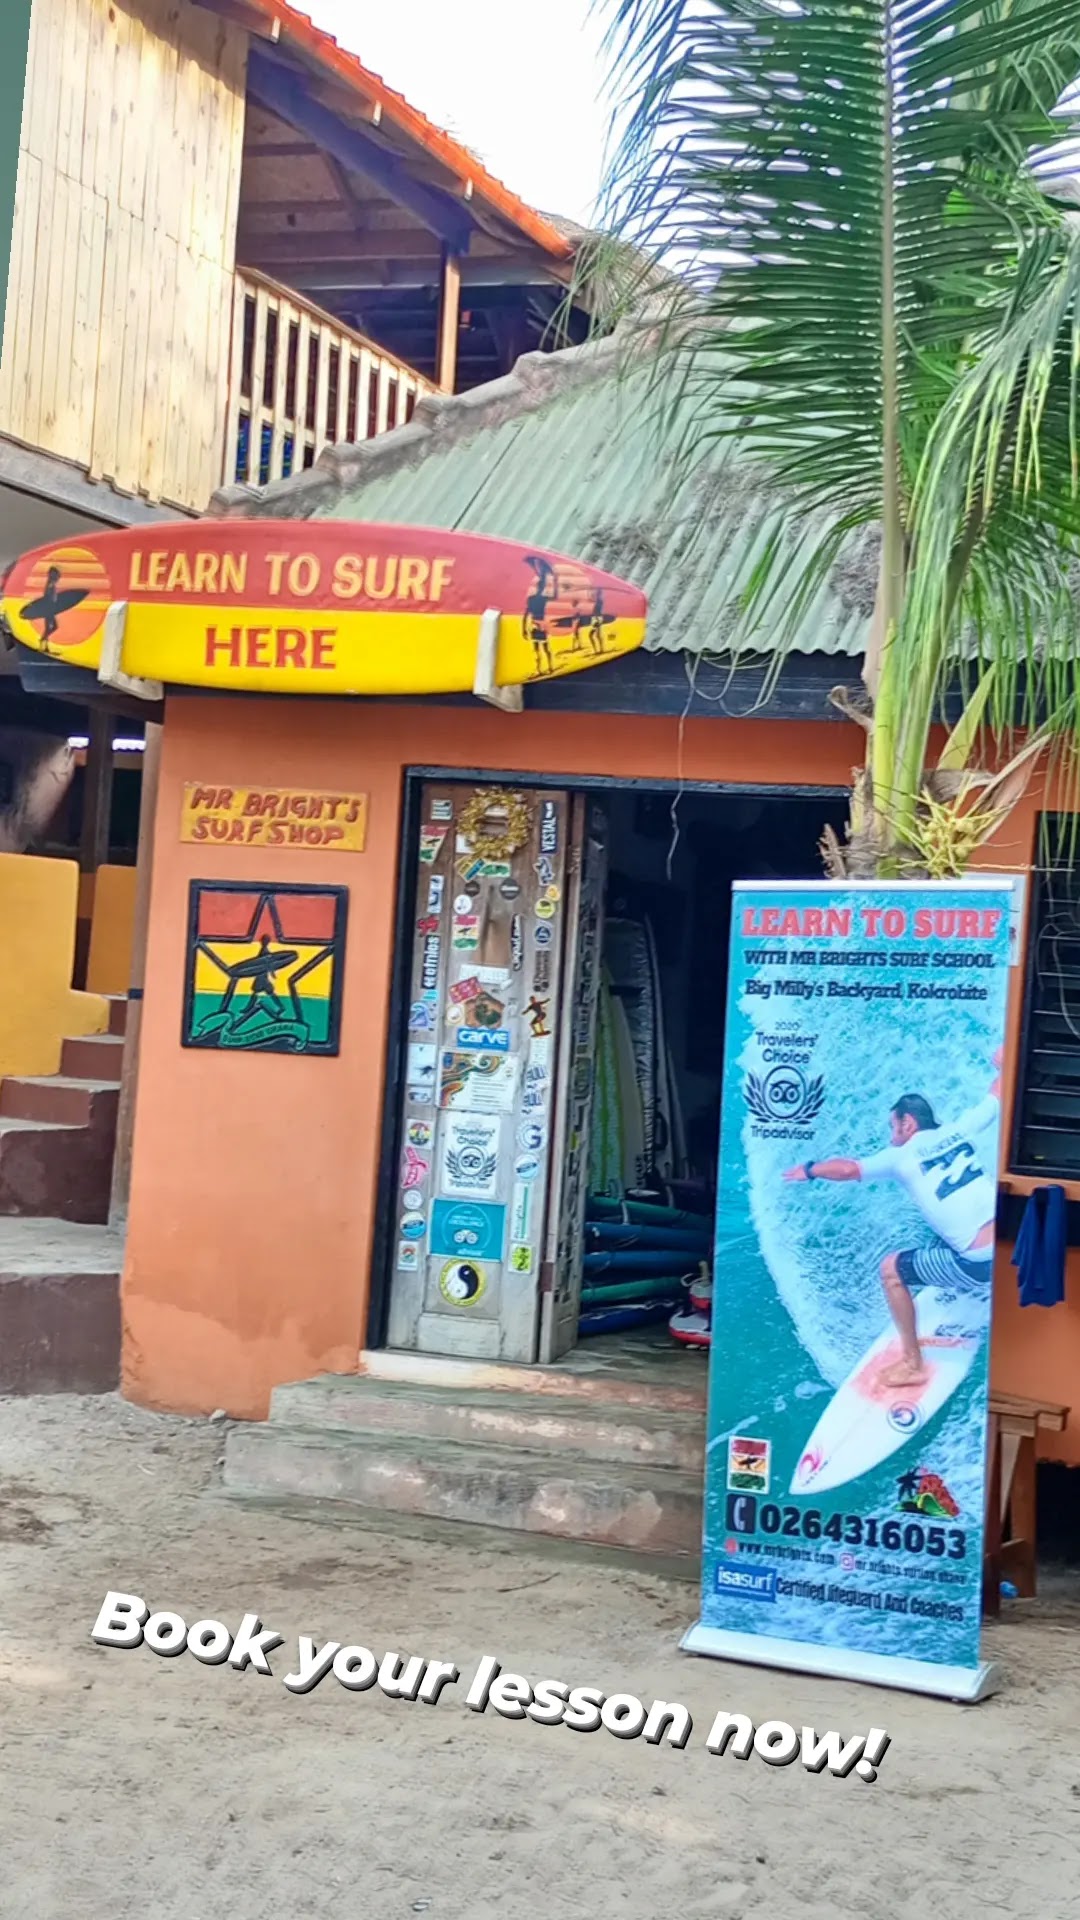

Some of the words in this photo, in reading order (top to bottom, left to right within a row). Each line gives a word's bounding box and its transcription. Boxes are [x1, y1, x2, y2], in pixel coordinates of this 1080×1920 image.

[129, 550, 247, 593] LEARN
[265, 552, 321, 597] TO
[332, 552, 456, 601] SURF
[204, 624, 338, 670] HERE
[190, 788, 233, 810] MR
[242, 793, 363, 823] BRIGHT'S
[192, 816, 264, 843] SURF
[266, 821, 345, 846] SHOP
[540, 816, 557, 852] VESTAL
[742, 908, 851, 938] LEARN
[860, 909, 906, 939] TO
[913, 909, 1002, 939] SURF
[744, 950, 786, 966] WITH
[790, 951, 817, 966] MR
[819, 951, 887, 967] BRIGHTS
[889, 952, 930, 967] SURF
[931, 953, 996, 969] SCHOOL
[745, 979, 772, 1000] Big
[774, 980, 825, 1001] Milly's
[762, 1048, 811, 1064] Choice
[750, 1125, 817, 1141] Tripadvisor
[760, 1503, 967, 1560] 0264316053
[717, 1566, 774, 1591] isasurf
[775, 1577, 826, 1601] Certified
